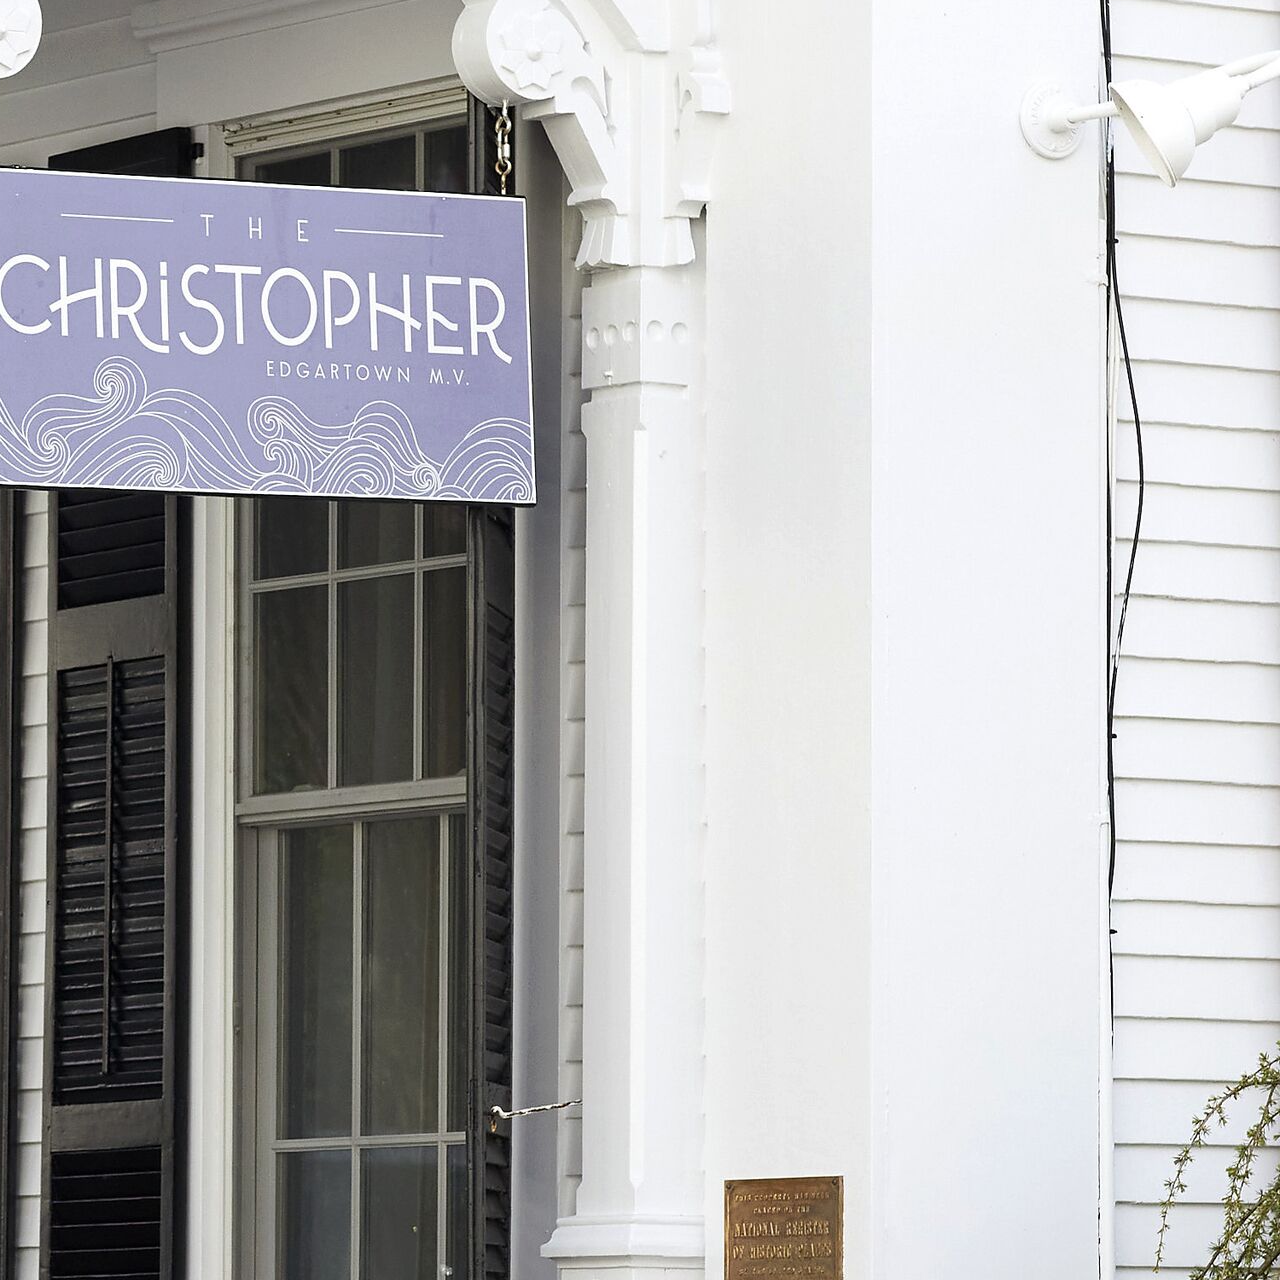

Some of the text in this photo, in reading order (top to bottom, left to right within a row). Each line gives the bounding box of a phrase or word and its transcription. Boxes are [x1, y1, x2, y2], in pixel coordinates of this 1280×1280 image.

[200, 213, 310, 243] THE
[266, 360, 471, 386] EDGARTOWN M.V.
[734, 1221, 780, 1237] NATIONAL
[750, 1244, 792, 1258] HISTORIC
